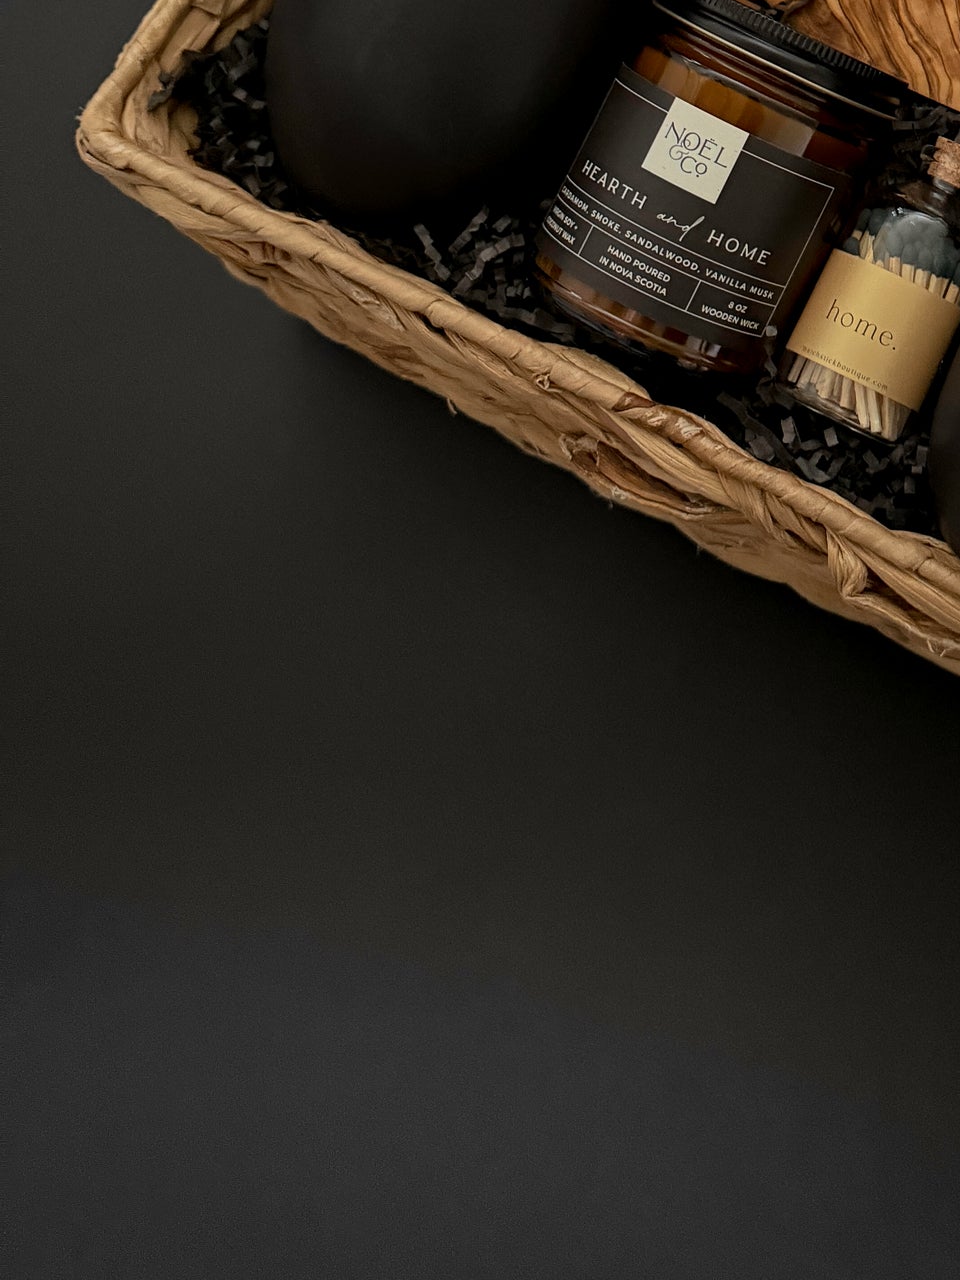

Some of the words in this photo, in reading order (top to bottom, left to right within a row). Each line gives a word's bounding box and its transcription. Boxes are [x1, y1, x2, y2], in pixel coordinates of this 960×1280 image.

[563, 215, 576, 229] SOY
[581, 159, 648, 210] HEARTH
[656, 212, 707, 243] and
[707, 229, 772, 266] HOME
[562, 228, 576, 245] WAX
[598, 255, 609, 266] IN
[609, 261, 633, 280] NOVA
[634, 274, 667, 297] SCOTIA
[607, 244, 633, 264] HAND
[632, 257, 671, 283] POURED
[624, 230, 701, 273] SANDALWOOD,
[705, 268, 747, 291] VANILLA
[749, 286, 775, 300] MUSK
[701, 304, 739, 325] WOODEN
[740, 318, 760, 330] WICK
[735, 304, 748, 314] OZ
[826, 298, 897, 351] home.
